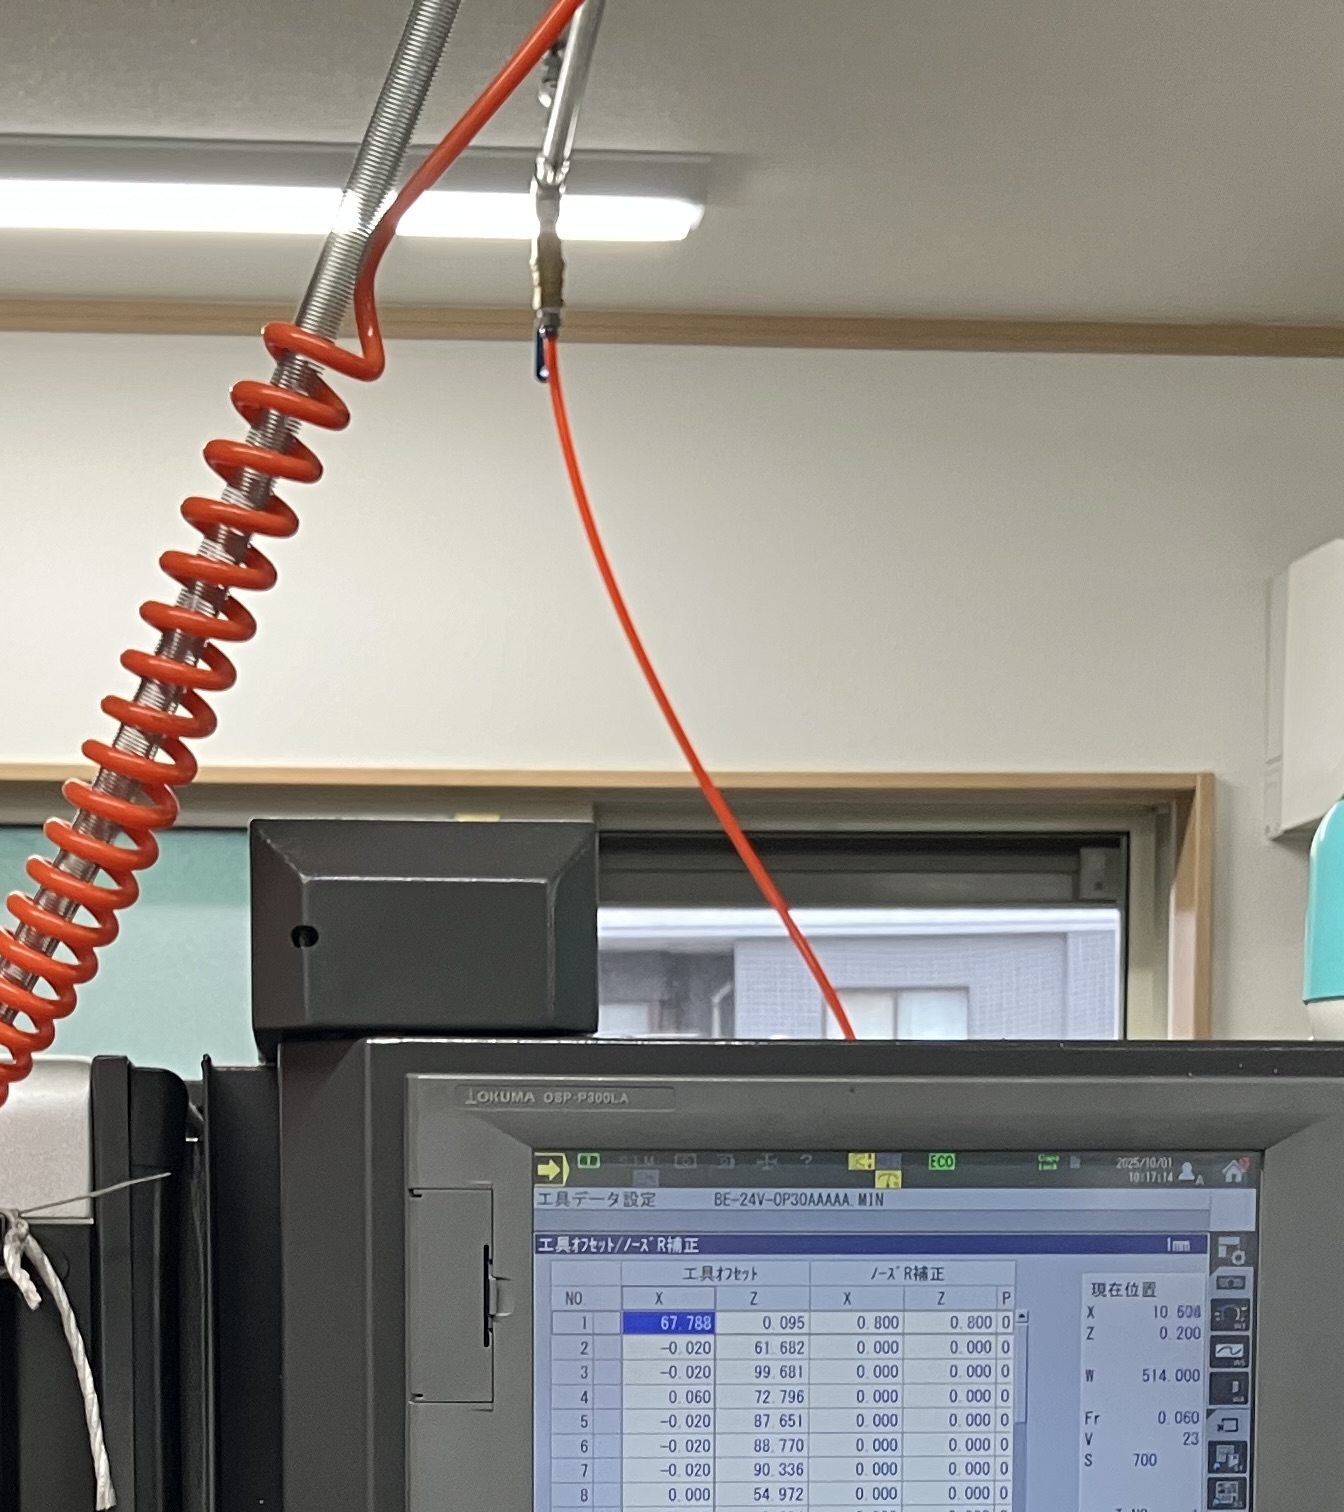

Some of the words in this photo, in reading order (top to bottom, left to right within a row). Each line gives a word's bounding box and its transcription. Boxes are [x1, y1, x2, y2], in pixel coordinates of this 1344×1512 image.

[477, 1091, 535, 1103] OKUMA
[930, 1155, 953, 1168] ECO
[1116, 1157, 1172, 1169] 2025/10/01
[538, 1192, 656, 1206] 工具データ設定
[1092, 1282, 1157, 1298] 現在位置
[656, 1291, 663, 1305] X
[750, 1291, 758, 1305] Z
[843, 1291, 851, 1305] X
[937, 1291, 945, 1305] Z
[1002, 1291, 1010, 1305] P
[1087, 1306, 1095, 1319] X
[661, 1316, 712, 1330] 67.788
[763, 1316, 805, 1330] 0.095
[1086, 1327, 1095, 1340] Z
[1160, 1327, 1201, 1340] 0.200
[660, 1341, 712, 1355] -0.020
[755, 1341, 805, 1355] 61.682
[660, 1365, 712, 1379] -0.020
[755, 1365, 803, 1379] 99.681
[1086, 1369, 1094, 1382] W
[1142, 1369, 1200, 1383] 514.000
[669, 1390, 711, 1404] 0.060
[755, 1390, 804, 1404] 72.796
[660, 1414, 711, 1428] -0.020
[754, 1414, 803, 1428] 87.651
[1085, 1411, 1100, 1425] Fr
[1158, 1411, 1199, 1424] 0.060
[1085, 1433, 1093, 1445] V
[1183, 1432, 1199, 1445] 23
[660, 1439, 711, 1453] -0.020
[754, 1439, 804, 1453] 88.770
[1084, 1453, 1092, 1467] S
[1133, 1453, 1157, 1467] 700
[660, 1462, 711, 1477] -0.020
[754, 1462, 804, 1477] 90.336
[668, 1487, 711, 1502] 0.000
[754, 1487, 804, 1502] 54.972
